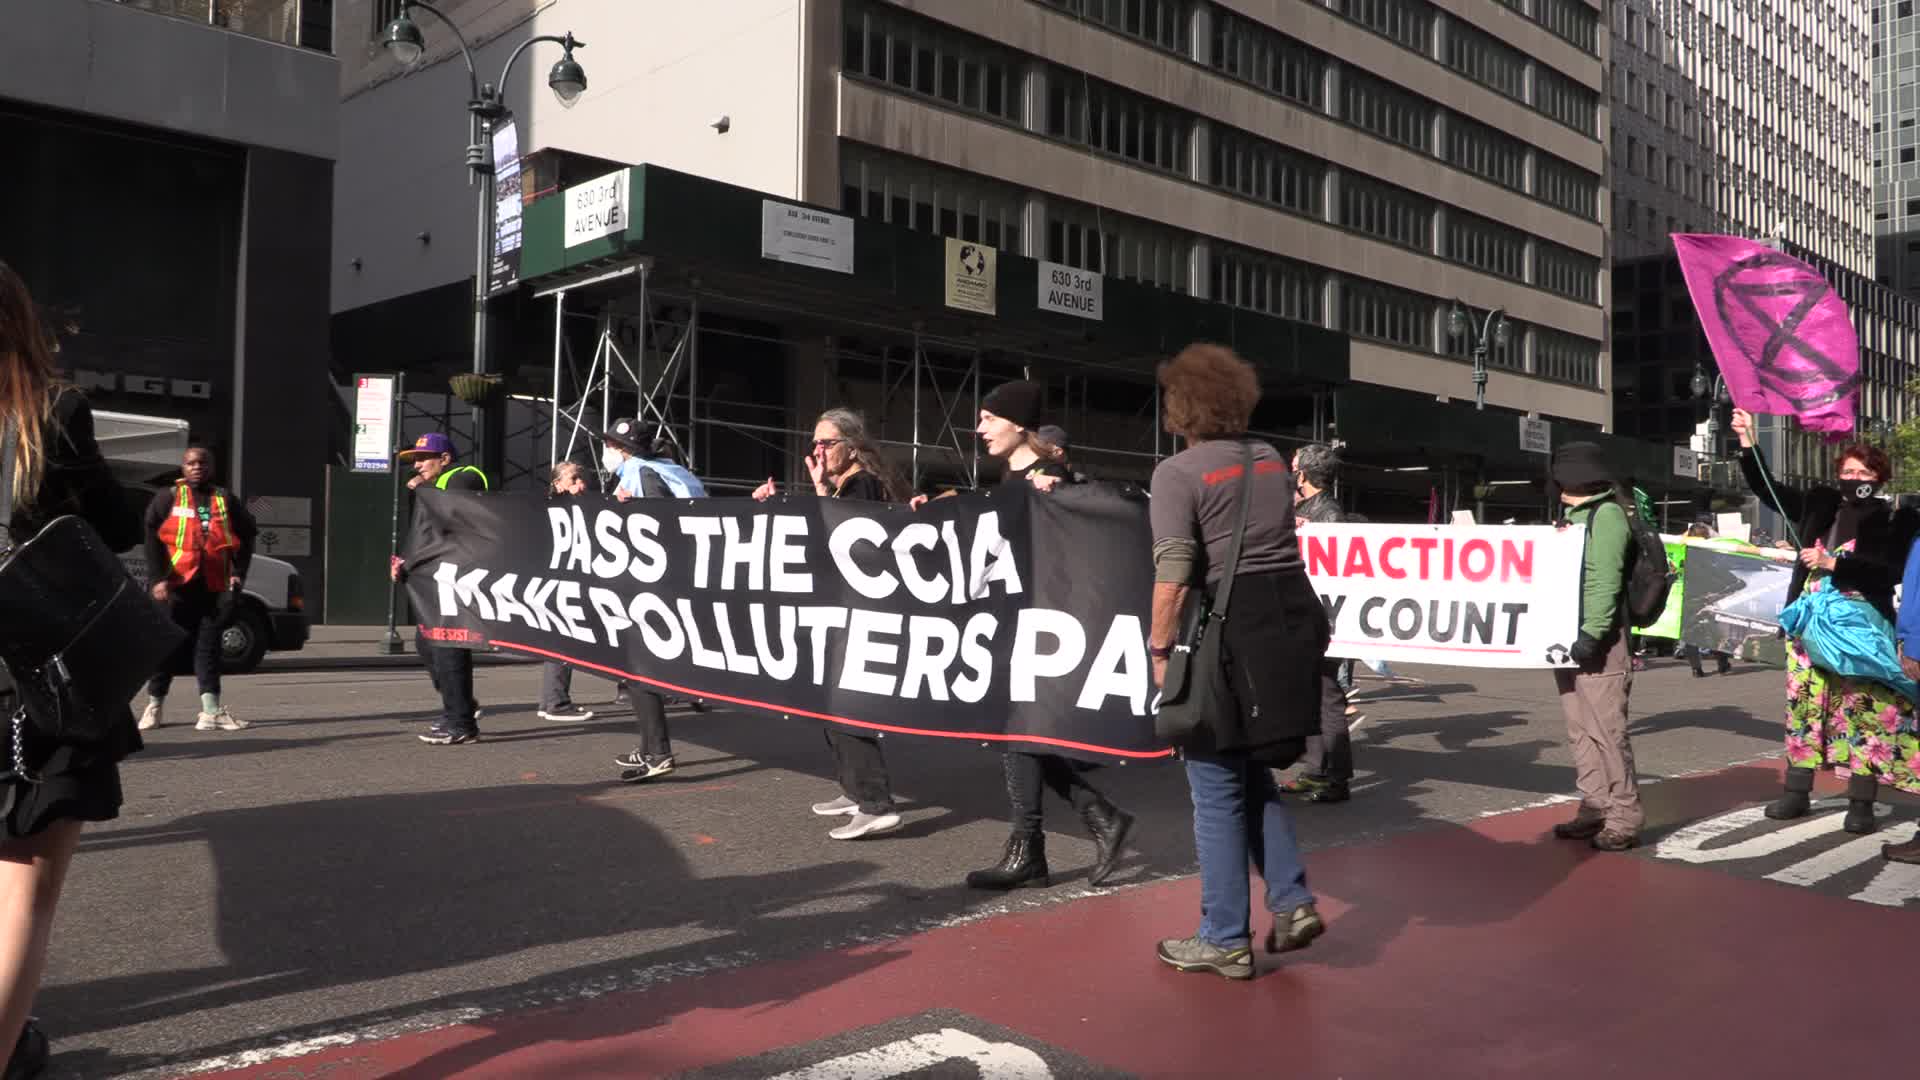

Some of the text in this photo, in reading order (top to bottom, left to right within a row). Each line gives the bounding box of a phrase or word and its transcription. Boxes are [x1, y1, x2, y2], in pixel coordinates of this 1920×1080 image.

[577, 180, 617, 210] 630 3rd
[575, 206, 619, 233] AVENUE
[1052, 270, 1092, 291] 630 3rd
[1048, 290, 1096, 312] AVENUE
[547, 505, 1024, 604] PASS THE CCIA
[1358, 596, 1529, 645] COUNT
[433, 562, 1162, 716] MAKE POLLUTERS PA
